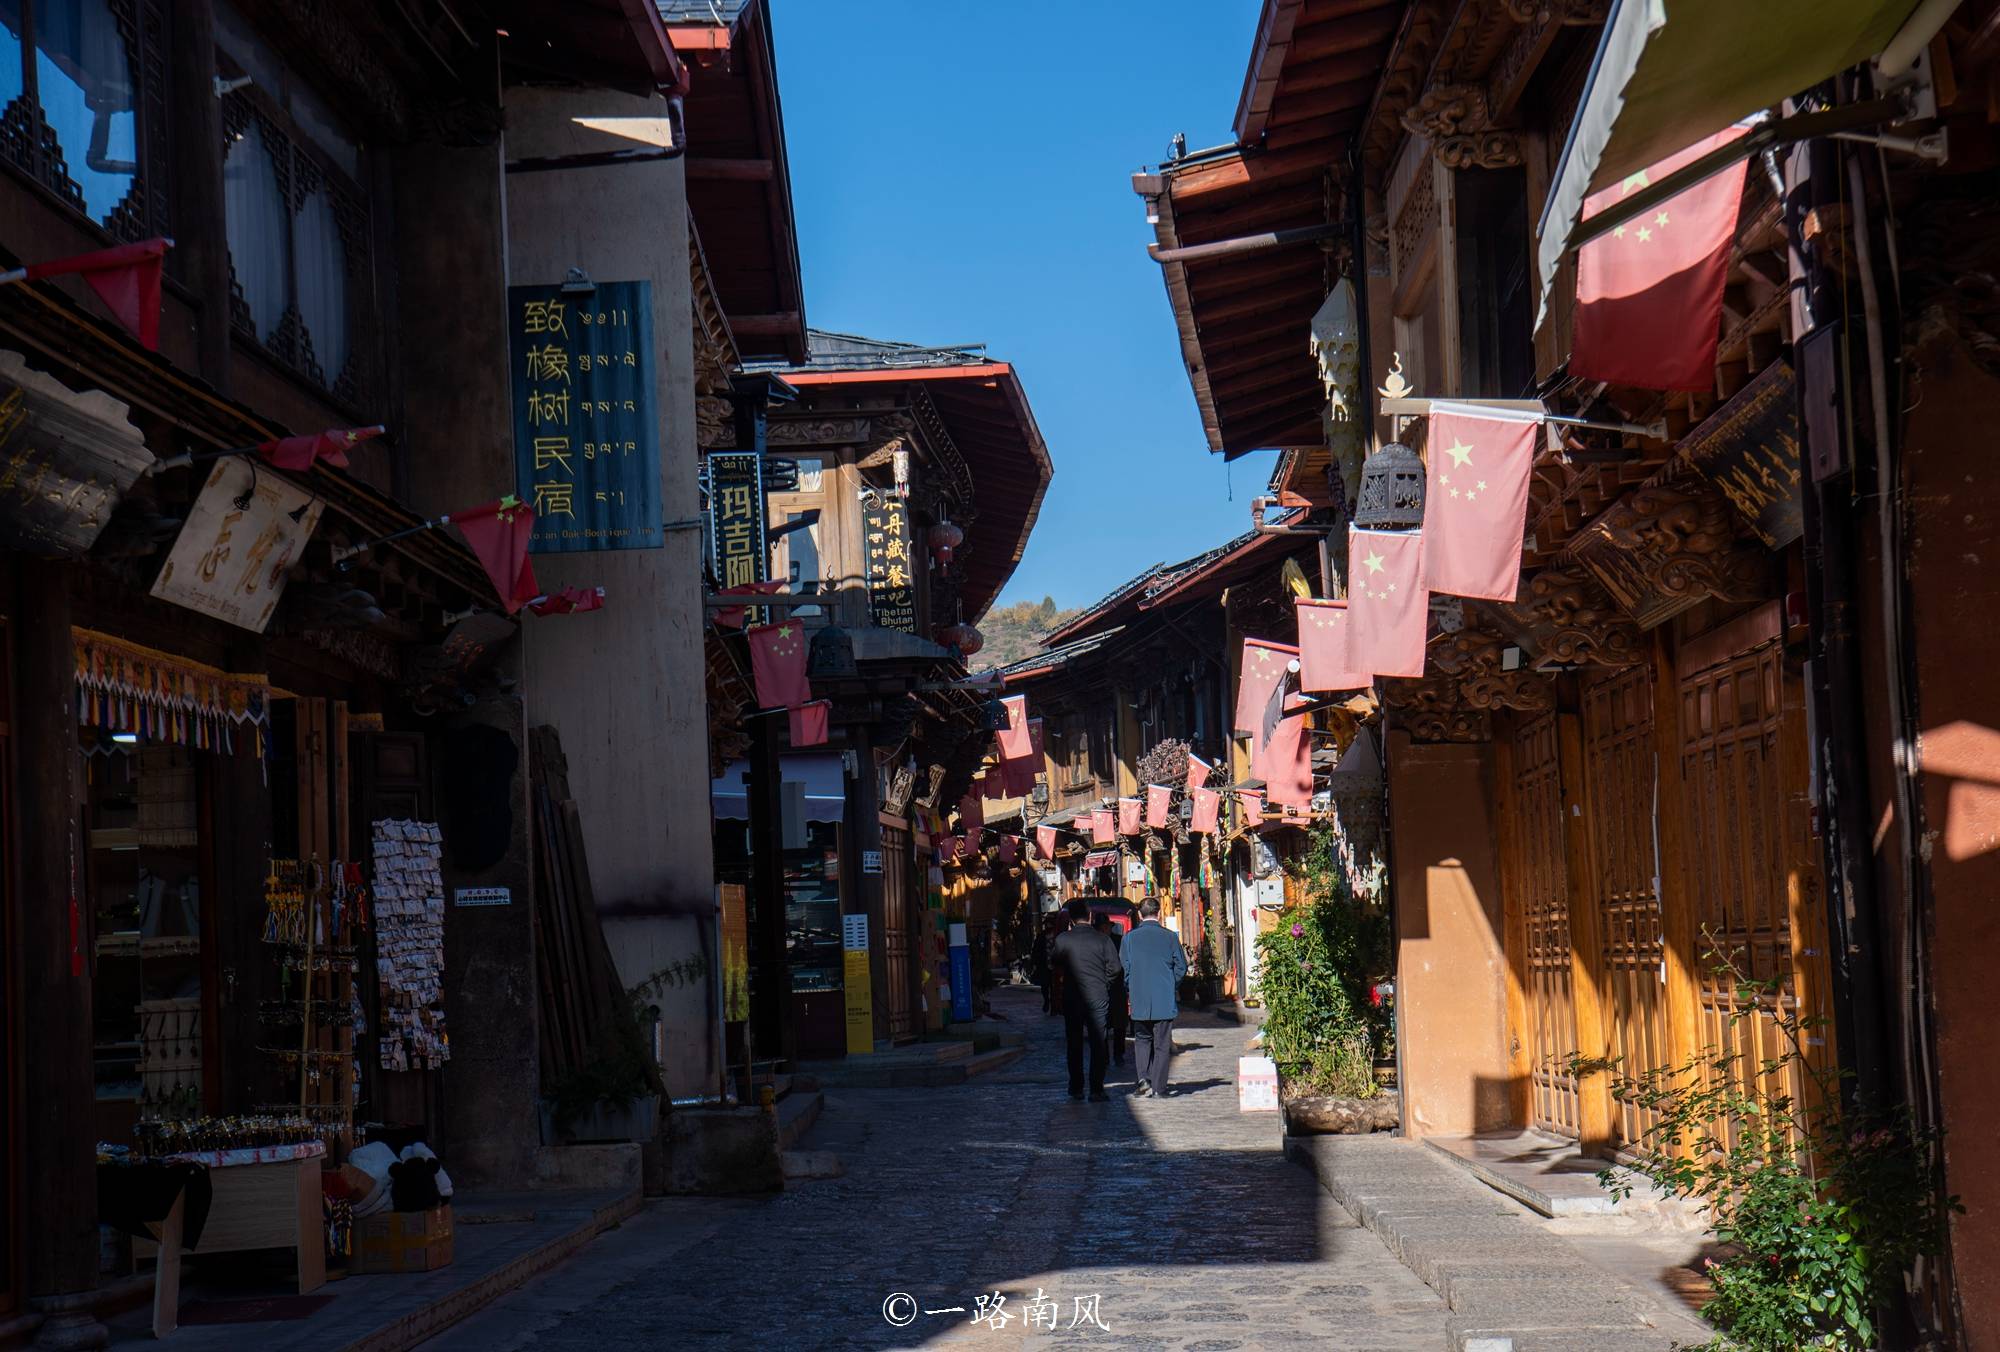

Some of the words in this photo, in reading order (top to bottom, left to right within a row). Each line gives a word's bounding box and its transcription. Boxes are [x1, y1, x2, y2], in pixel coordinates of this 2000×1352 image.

[524, 299, 576, 520] 致橡树民宿
[721, 484, 761, 632] 玛吉阿
[874, 608, 913, 617] Tibetan
[881, 616, 913, 626] Bhutan
